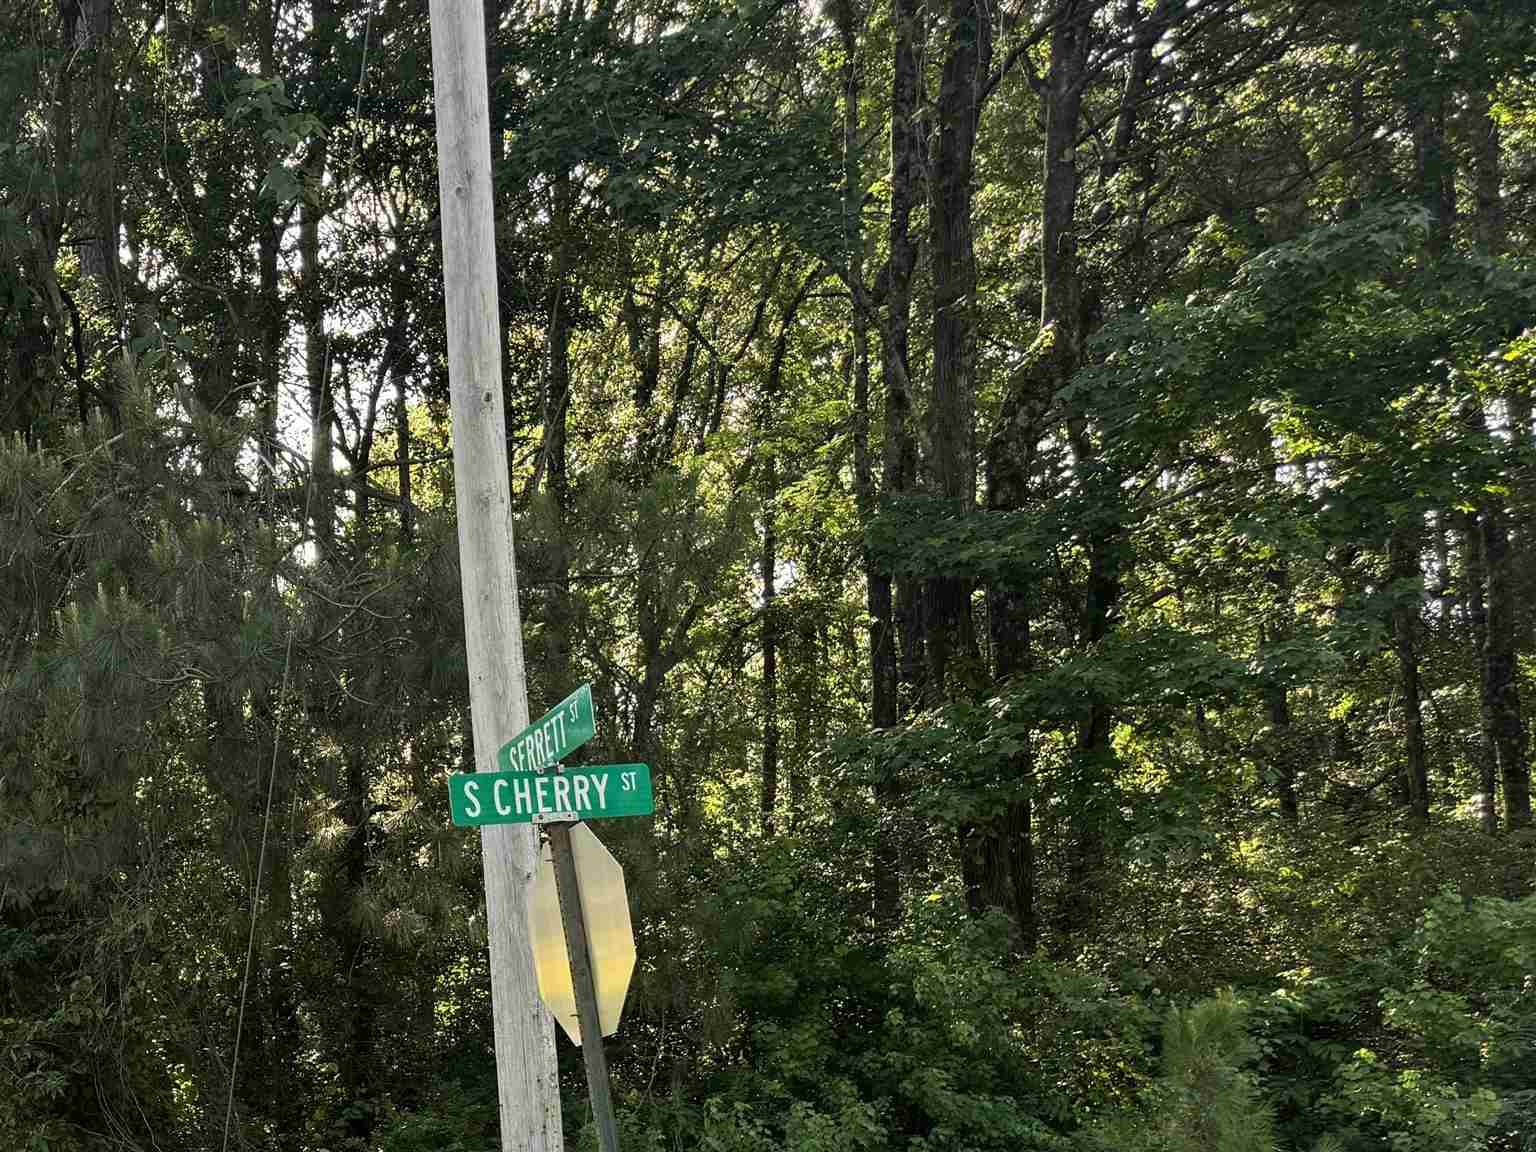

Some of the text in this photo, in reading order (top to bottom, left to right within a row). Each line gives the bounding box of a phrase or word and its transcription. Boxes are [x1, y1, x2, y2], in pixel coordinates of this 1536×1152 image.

[569, 700, 579, 723] ST
[464, 771, 637, 818] S CHERRY ST
